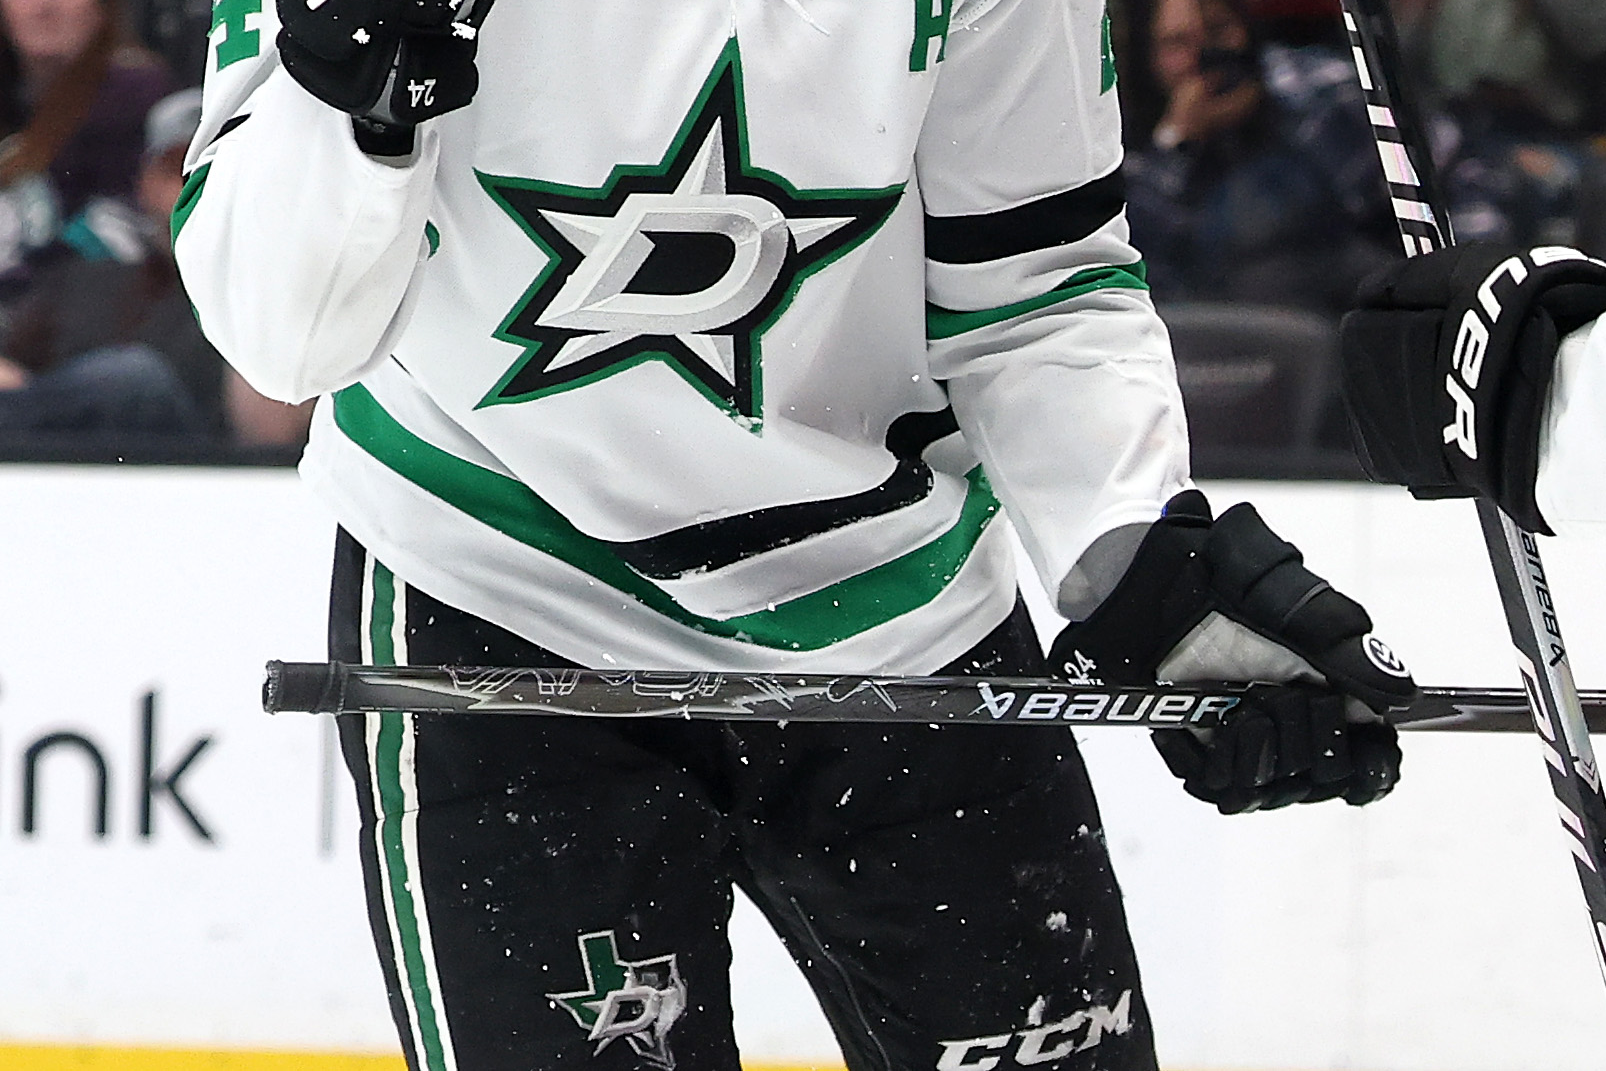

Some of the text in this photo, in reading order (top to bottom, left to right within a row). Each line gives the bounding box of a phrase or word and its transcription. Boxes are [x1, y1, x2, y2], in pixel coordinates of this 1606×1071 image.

[407, 78, 437, 108] 24
[1064, 649, 1097, 683] 24
[0, 679, 216, 844] nk
[935, 988, 1134, 1071] CCM
